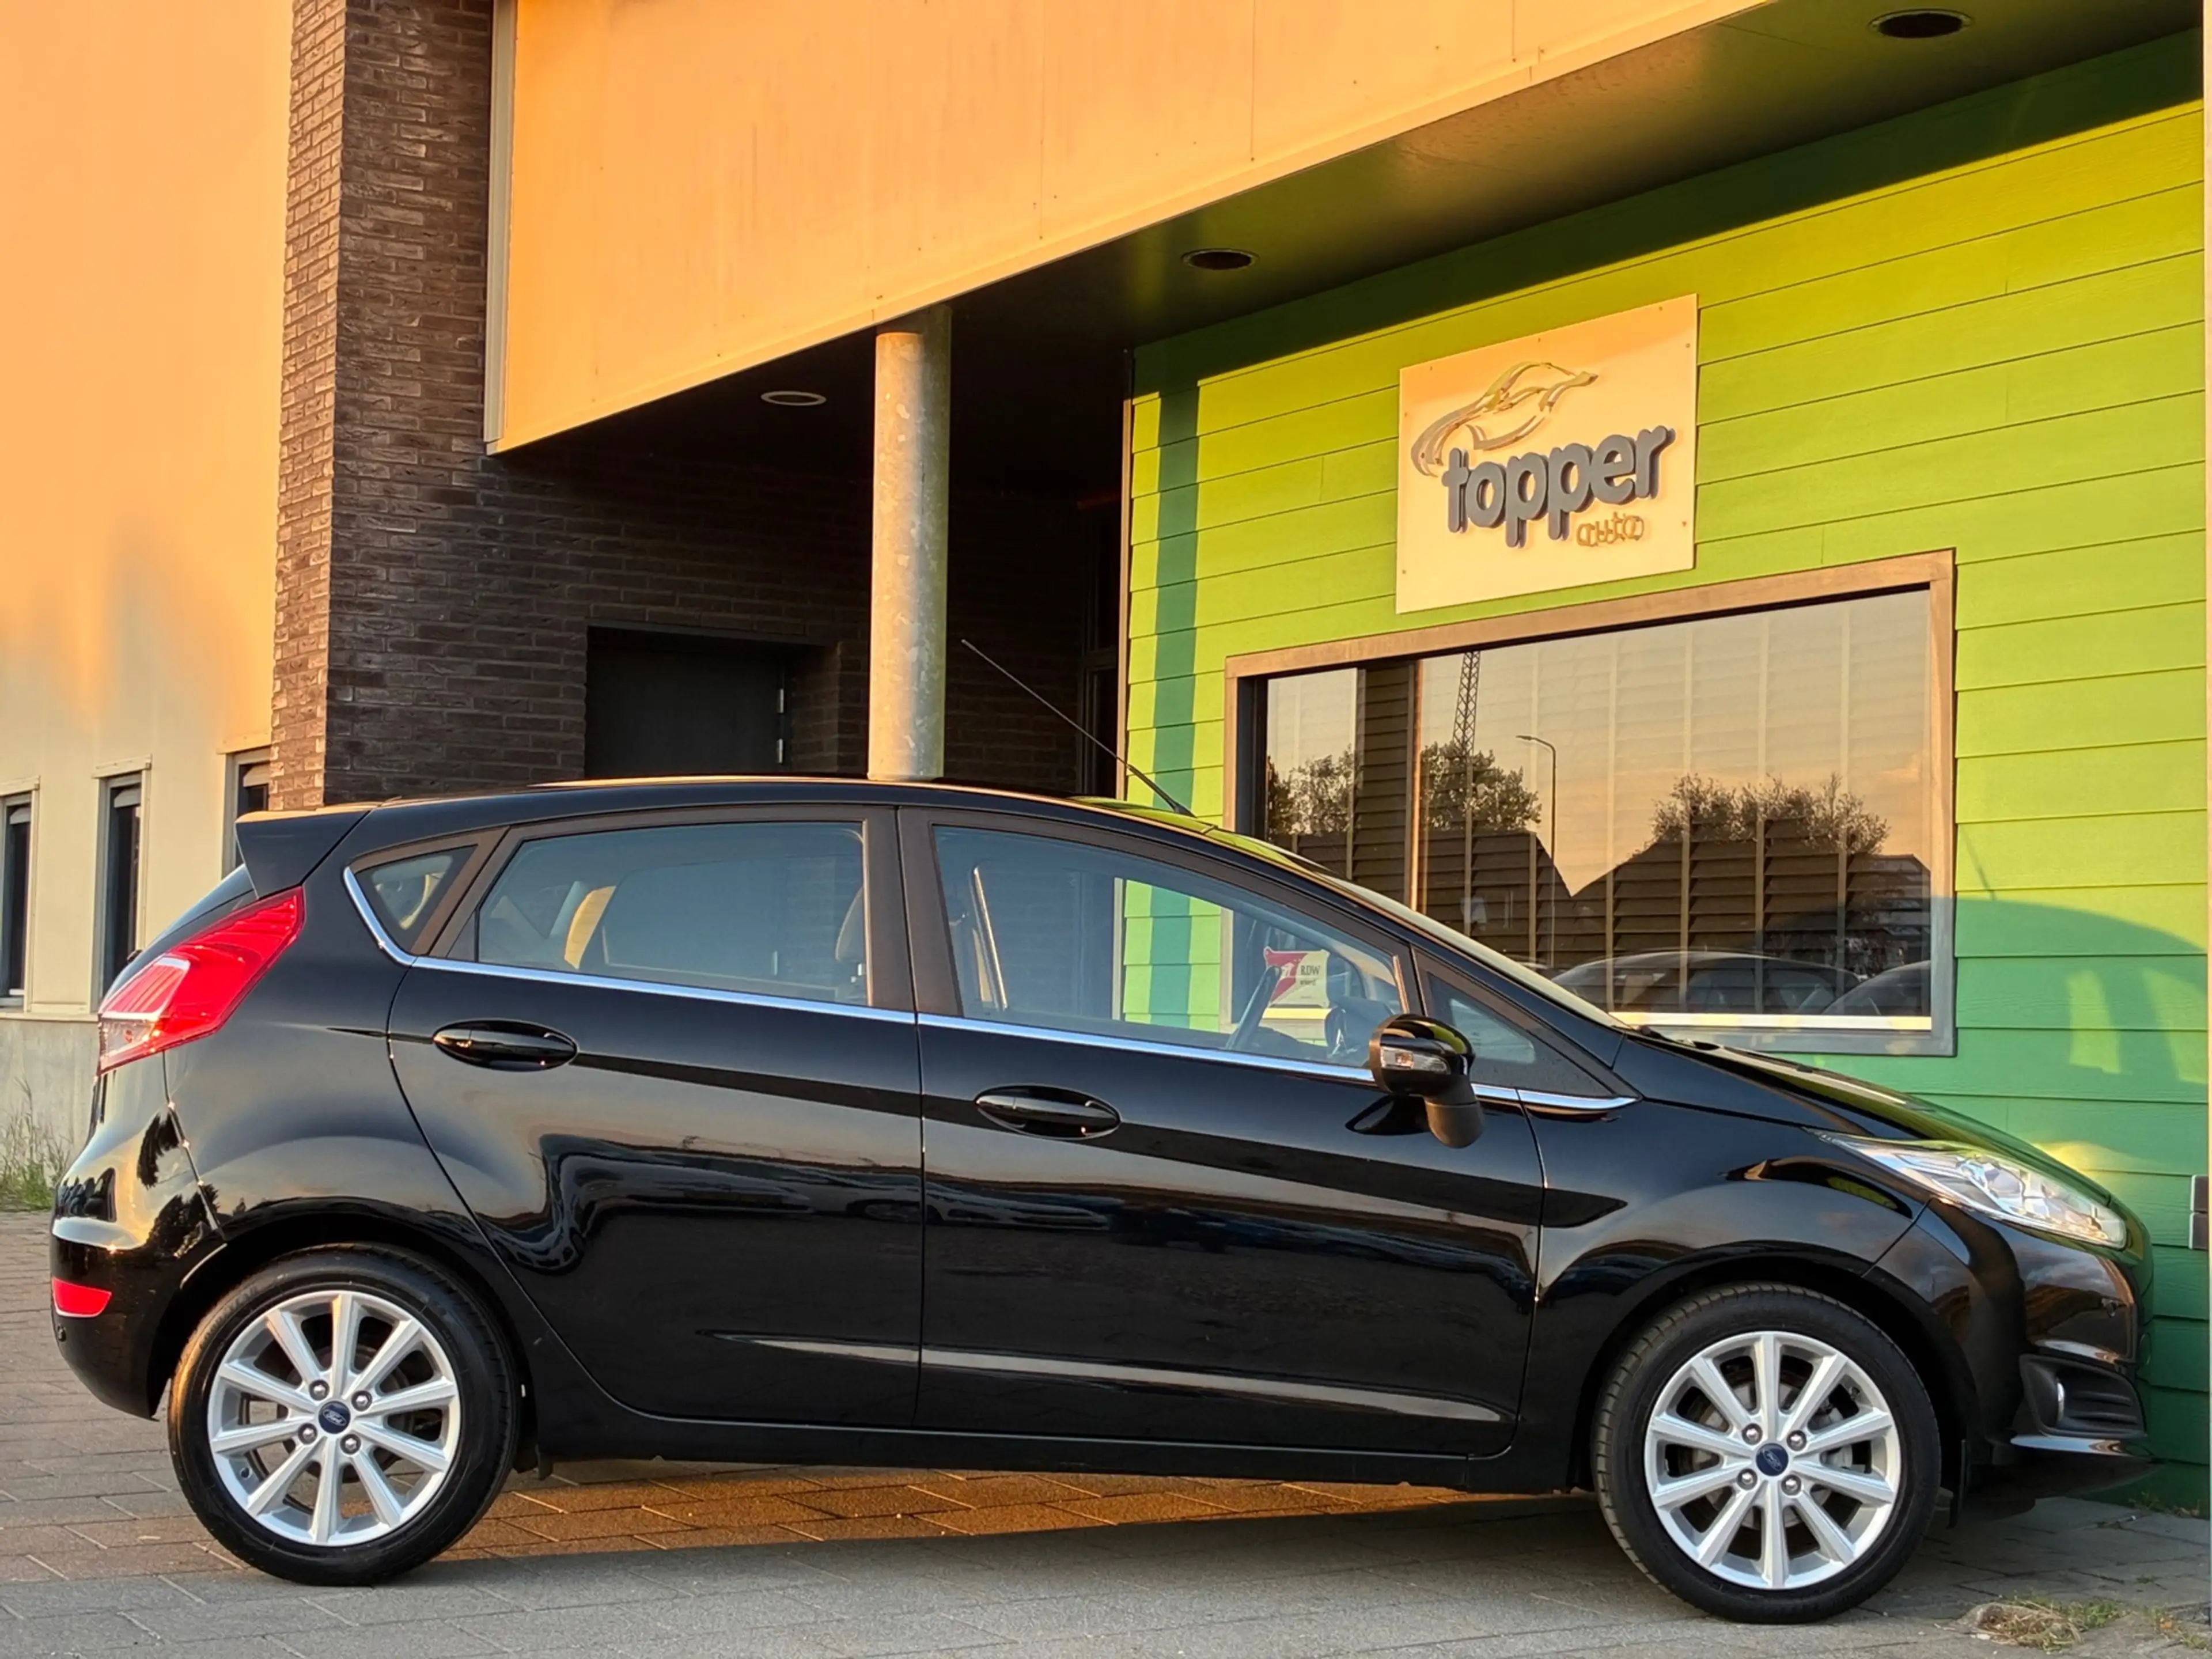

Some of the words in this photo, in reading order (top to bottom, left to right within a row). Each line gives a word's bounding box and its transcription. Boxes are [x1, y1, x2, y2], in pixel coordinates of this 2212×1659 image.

[1441, 425, 1676, 548] topper
[1576, 511, 1645, 547] auto
[1301, 965, 1321, 975] RDW
